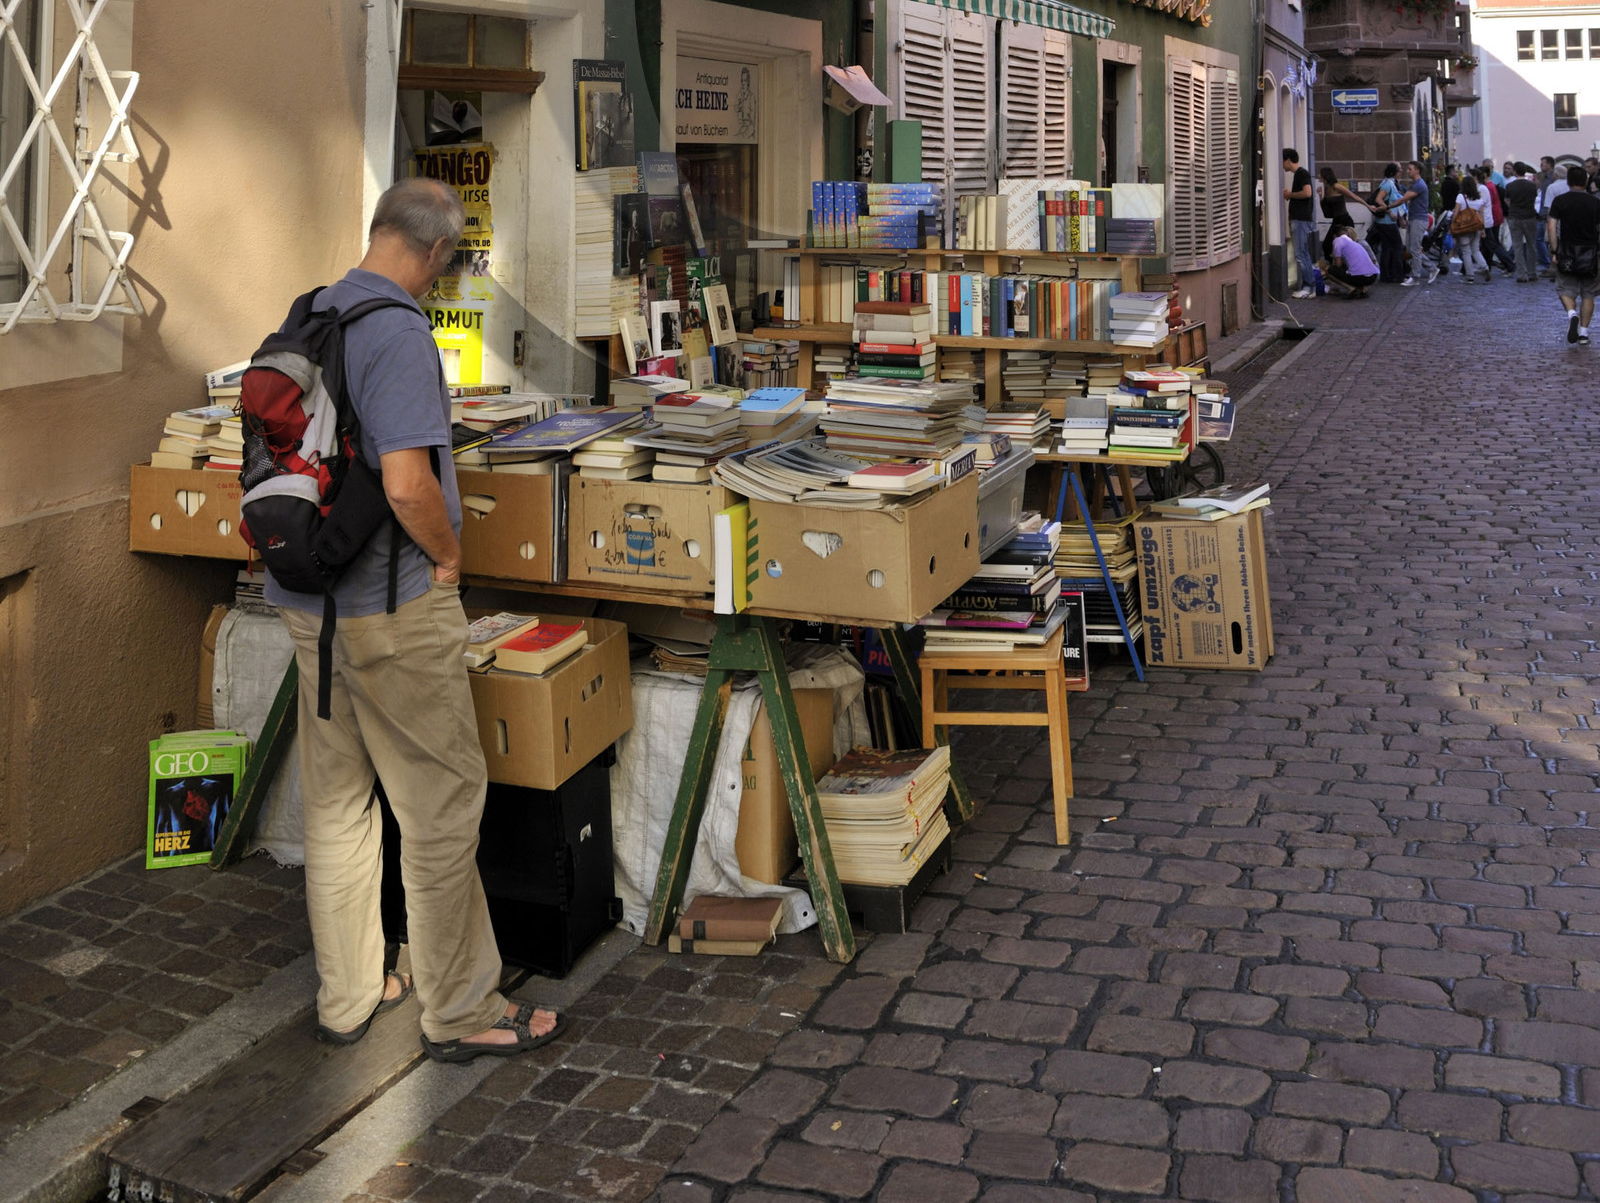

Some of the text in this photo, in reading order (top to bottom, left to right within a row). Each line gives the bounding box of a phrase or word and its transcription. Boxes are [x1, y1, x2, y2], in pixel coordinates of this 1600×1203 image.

[696, 72, 729, 88] Antiquariat
[696, 90, 729, 110] HEINE
[690, 126, 702, 135] von
[704, 124, 729, 136] Büchern
[416, 151, 490, 186] TANGO
[1139, 526, 1166, 663] zapf umzüge
[1237, 525, 1256, 665] Wir machen Ihren Möbeln Beine.
[154, 752, 208, 776] GEO
[742, 776, 756, 790] AG
[154, 836, 190, 853] HERZ
